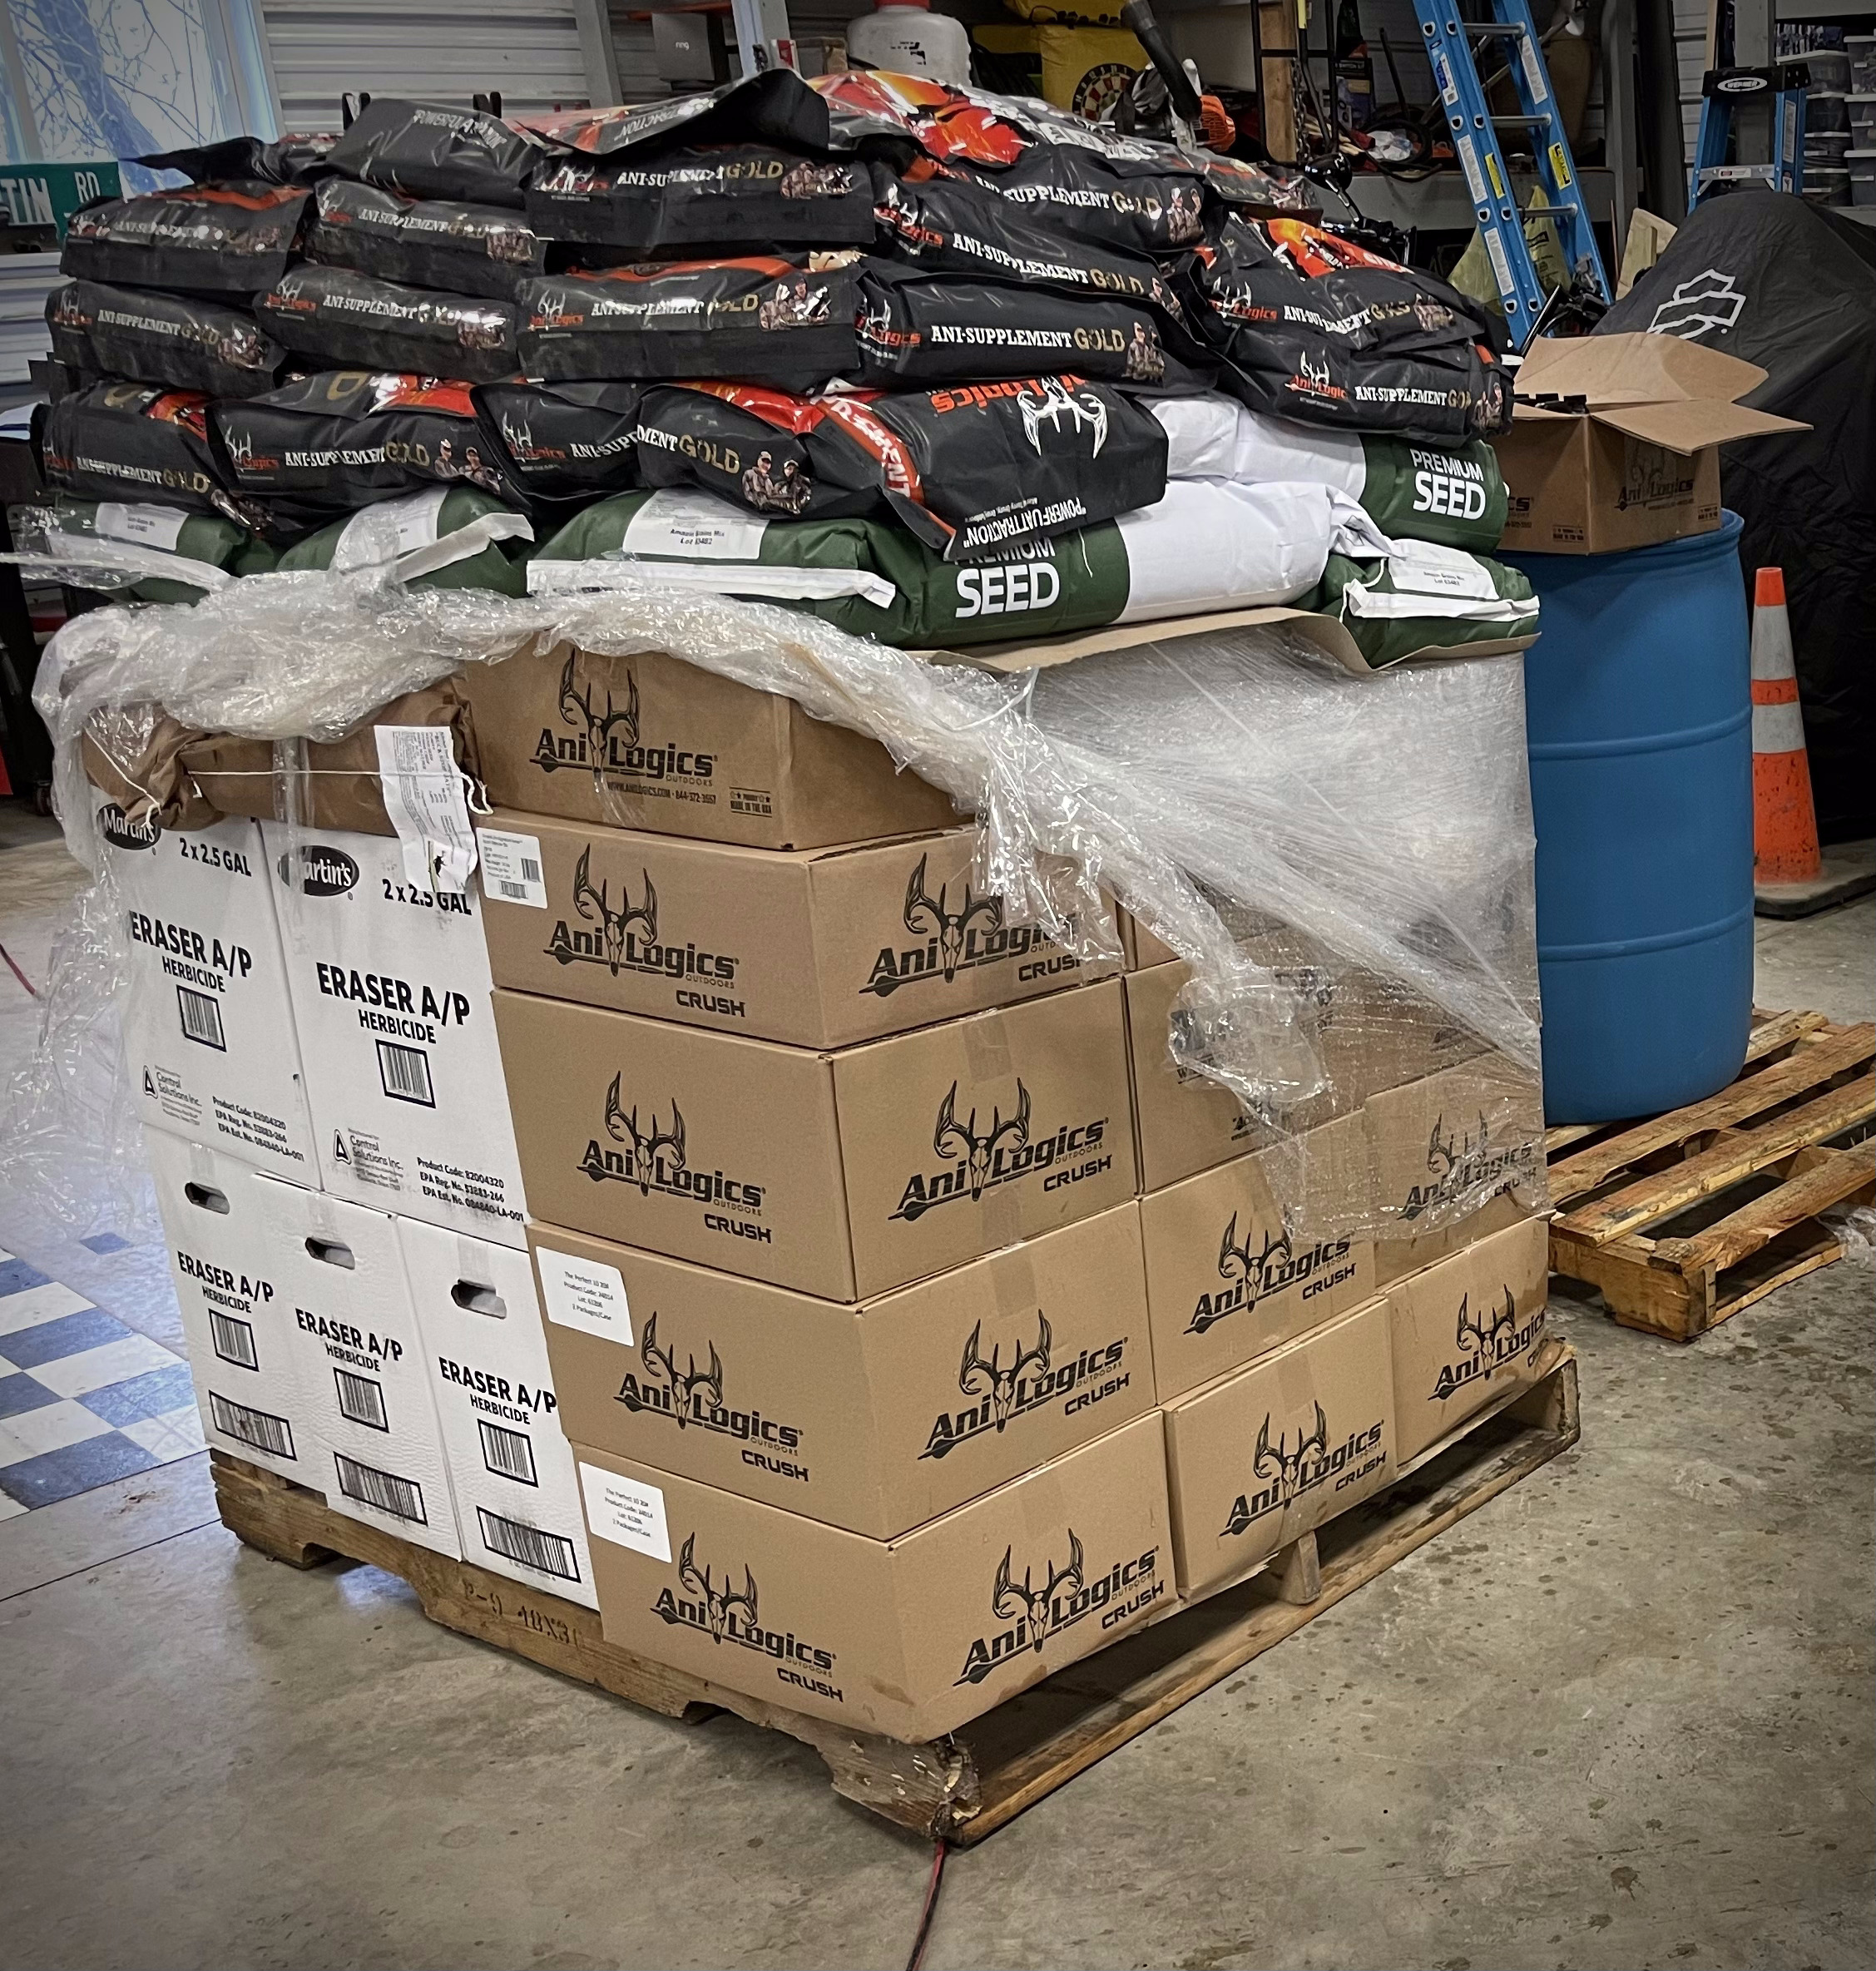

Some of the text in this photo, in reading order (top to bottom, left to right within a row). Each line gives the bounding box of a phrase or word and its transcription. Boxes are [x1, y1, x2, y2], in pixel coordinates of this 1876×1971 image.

[676, 40, 690, 51] ring
[74, 171, 101, 204] RD
[953, 232, 1089, 285] ANI-SUPPLEMENT
[931, 324, 1126, 353] ANI-SUPPLEMENT GOLD
[1354, 386, 1448, 407] ANI-SUPPLEMENT
[679, 434, 741, 474] GOLD
[1410, 448, 1484, 482] PREMIUM
[1413, 470, 1487, 520] SEED
[956, 562, 1060, 619] SEED
[535, 728, 715, 780] Ani Logics
[666, 774, 713, 787] OUTDOORS
[180, 838, 252, 877] 2 x 2.5 GAL
[383, 879, 394, 900] 2
[395, 886, 406, 903] x
[437, 892, 472, 915] GAL
[129, 910, 252, 978] ERASER A/P
[549, 920, 735, 979] Ani Logics
[868, 934, 938, 984] Ani
[162, 956, 226, 993] HERBICIDE
[686, 973, 735, 989] OUTDOORS
[316, 962, 471, 1027] ERASER A/P
[676, 989, 746, 1018] CRUSH
[359, 1009, 437, 1044] HERBICIDE
[212, 1096, 235, 1112] Product
[215, 1109, 228, 1121] EPA
[218, 1122, 230, 1135] EPA
[417, 1157, 443, 1172] Product
[897, 1119, 1105, 1211] Ani Logics
[1055, 1141, 1103, 1165] OUTDOORS
[420, 1171, 434, 1183] EPA
[435, 1176, 450, 1189] Reg.
[451, 1181, 464, 1191] No.
[582, 1140, 761, 1206] Ani Logics
[1043, 1154, 1112, 1192] CRUSH
[423, 1186, 437, 1198] EPA
[452, 1194, 464, 1206] No.
[714, 1198, 762, 1217] OUTDOORS
[705, 1213, 772, 1244] CRUSH
[177, 1250, 275, 1303] ERASER A/P
[1190, 1233, 1351, 1325] Ani Logics
[1302, 1262, 1357, 1300] CRUSH
[1312, 1252, 1349, 1275] OUTDOORS
[202, 1285, 252, 1314] HERBICIDE
[295, 1308, 403, 1362] ERASER A/P
[325, 1343, 381, 1373] HERBICIDE
[1076, 1361, 1122, 1389] OUTDOORS
[1433, 1349, 1480, 1393] Ani
[438, 1357, 557, 1414] ERASER A/P
[925, 1340, 1123, 1450] Ani Logics
[1065, 1372, 1131, 1416] CRUSH
[470, 1394, 531, 1426] HERBICIDE
[619, 1373, 799, 1448] Ani Logics
[750, 1436, 799, 1457] OUTDOORS
[741, 1449, 809, 1483] CRUSH
[1225, 1420, 1382, 1528] Ani Logics
[1335, 1450, 1387, 1492] CRUSH
[1111, 1569, 1156, 1602] OUTDOORS
[961, 1548, 1156, 1676] Ani Logics
[1101, 1579, 1165, 1630] CRUSH
[656, 1587, 833, 1670] Ani Logics
[777, 1667, 844, 1703] CRUSH
[785, 1657, 833, 1677] OUTDOORS
